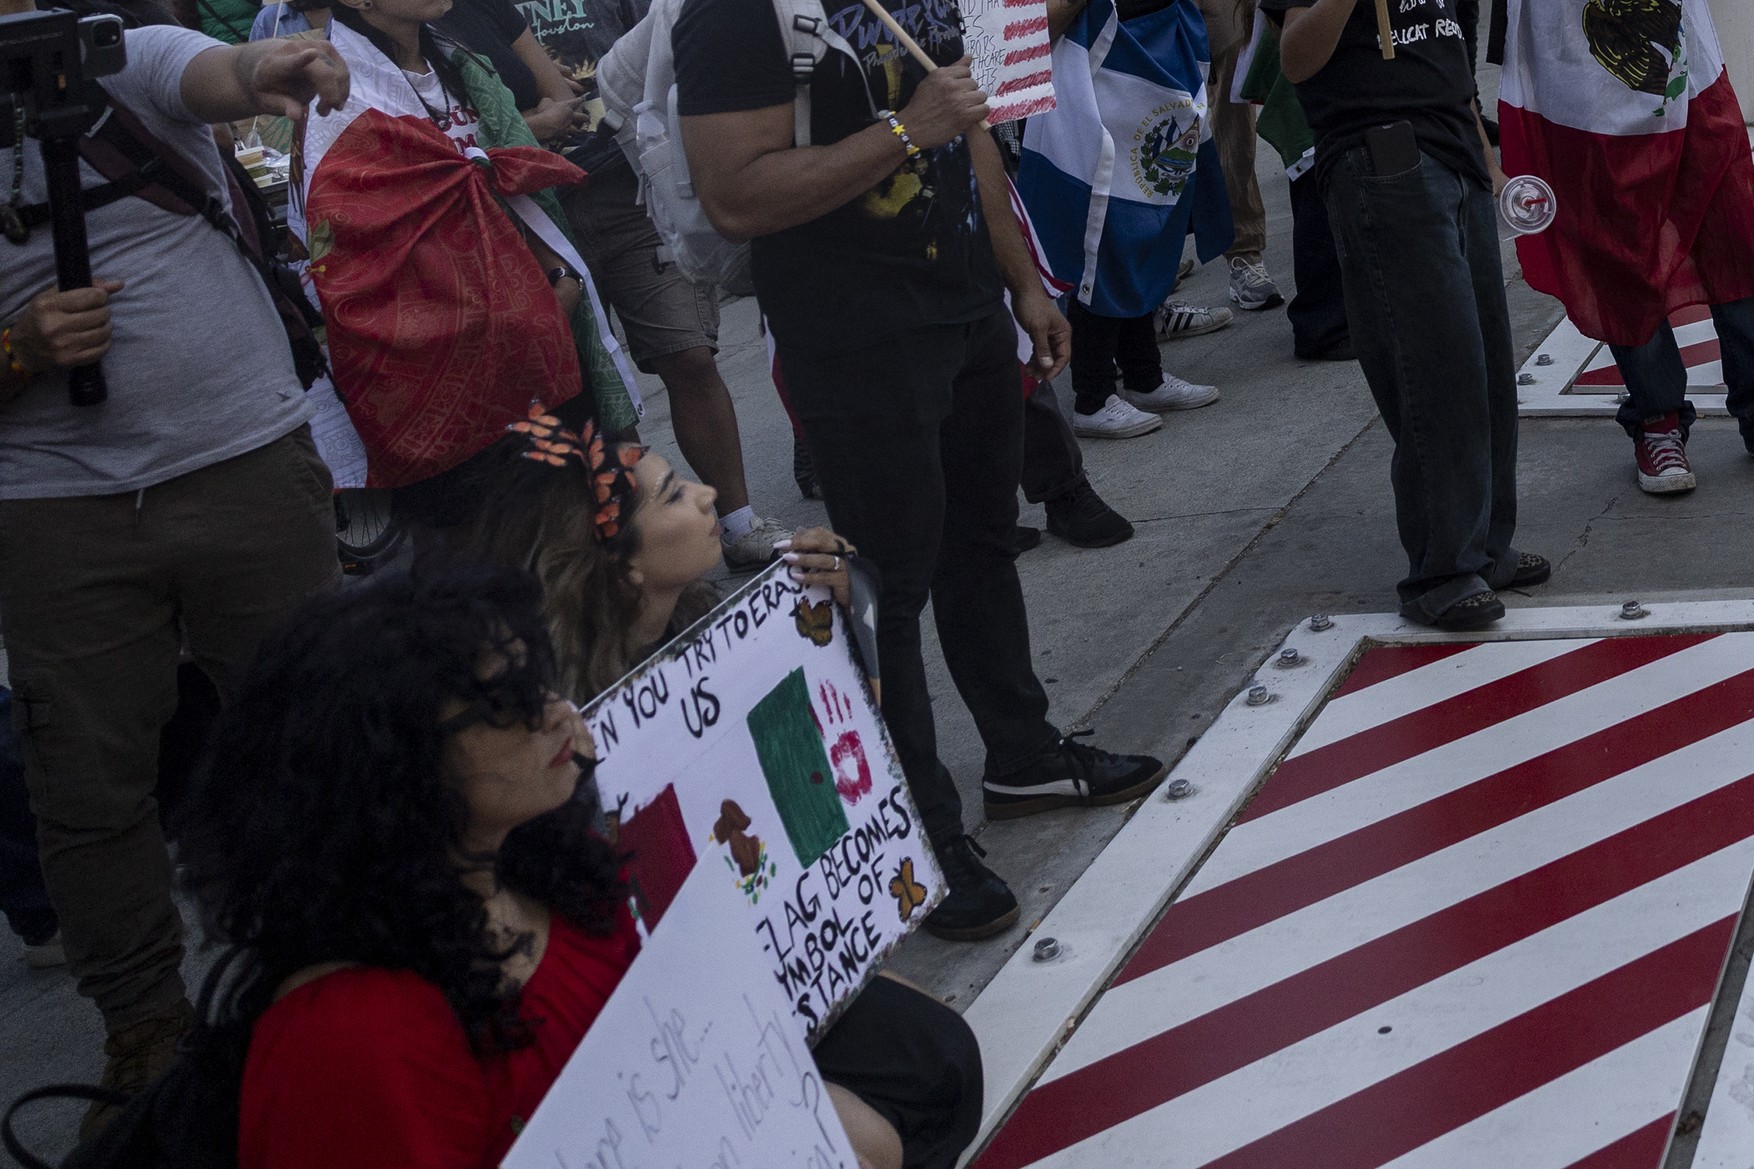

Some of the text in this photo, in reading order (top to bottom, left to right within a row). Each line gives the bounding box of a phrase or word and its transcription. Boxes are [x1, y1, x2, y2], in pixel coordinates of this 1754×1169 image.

[970, 49, 1006, 72] THCARE
[976, 68, 997, 84] HTS
[1133, 128, 1144, 141] DE
[1142, 117, 1152, 128] EL
[1152, 99, 1193, 117] SALVAD
[623, 565, 811, 728] YOU TRY TO ERAS
[680, 676, 720, 739] US
[820, 785, 911, 901] BECOMES
[773, 852, 885, 1001] YMBOL OF
[794, 910, 882, 1040] STANCE
